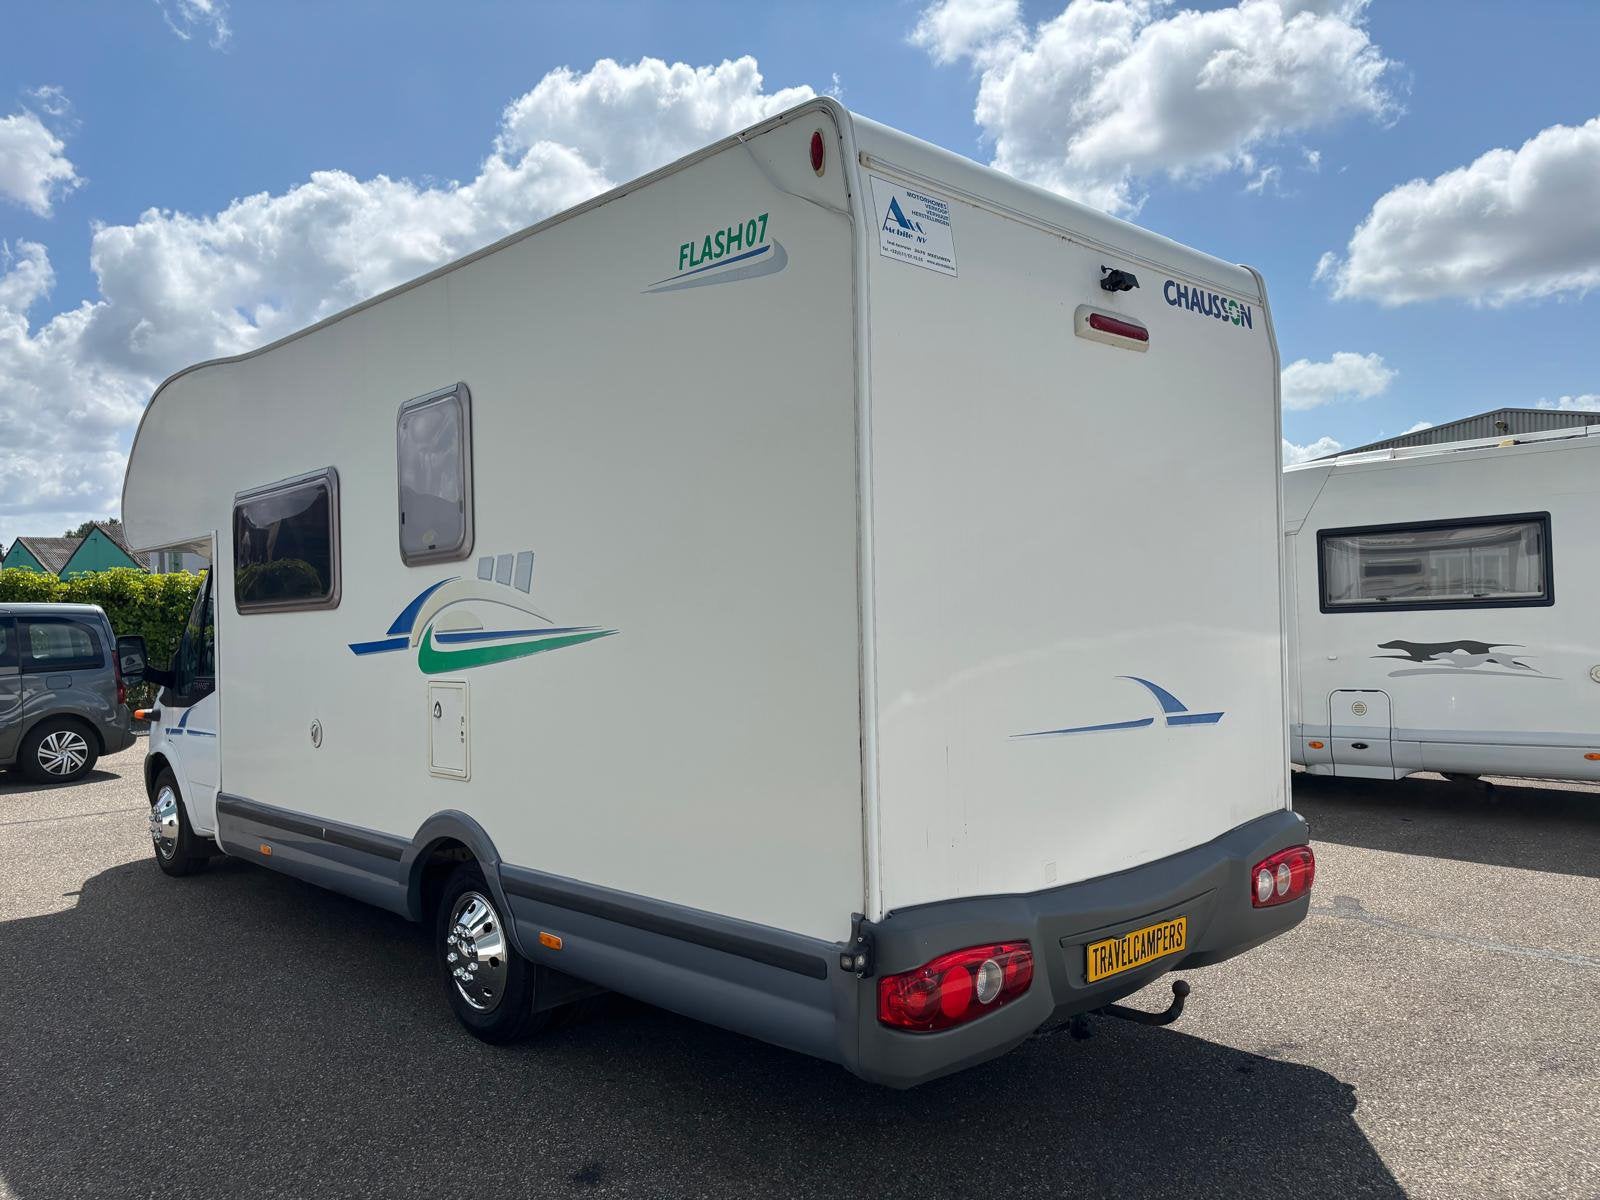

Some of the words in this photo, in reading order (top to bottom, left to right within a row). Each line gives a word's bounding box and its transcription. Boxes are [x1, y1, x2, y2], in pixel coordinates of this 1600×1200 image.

[906, 191, 947, 209] MOTORHOMES
[911, 210, 950, 227] HERSTELLINGEN
[916, 236, 928, 244] NV
[1163, 280, 1253, 329] CHAUSSON
[1092, 922, 1183, 976] TRAVELCAMPERS
